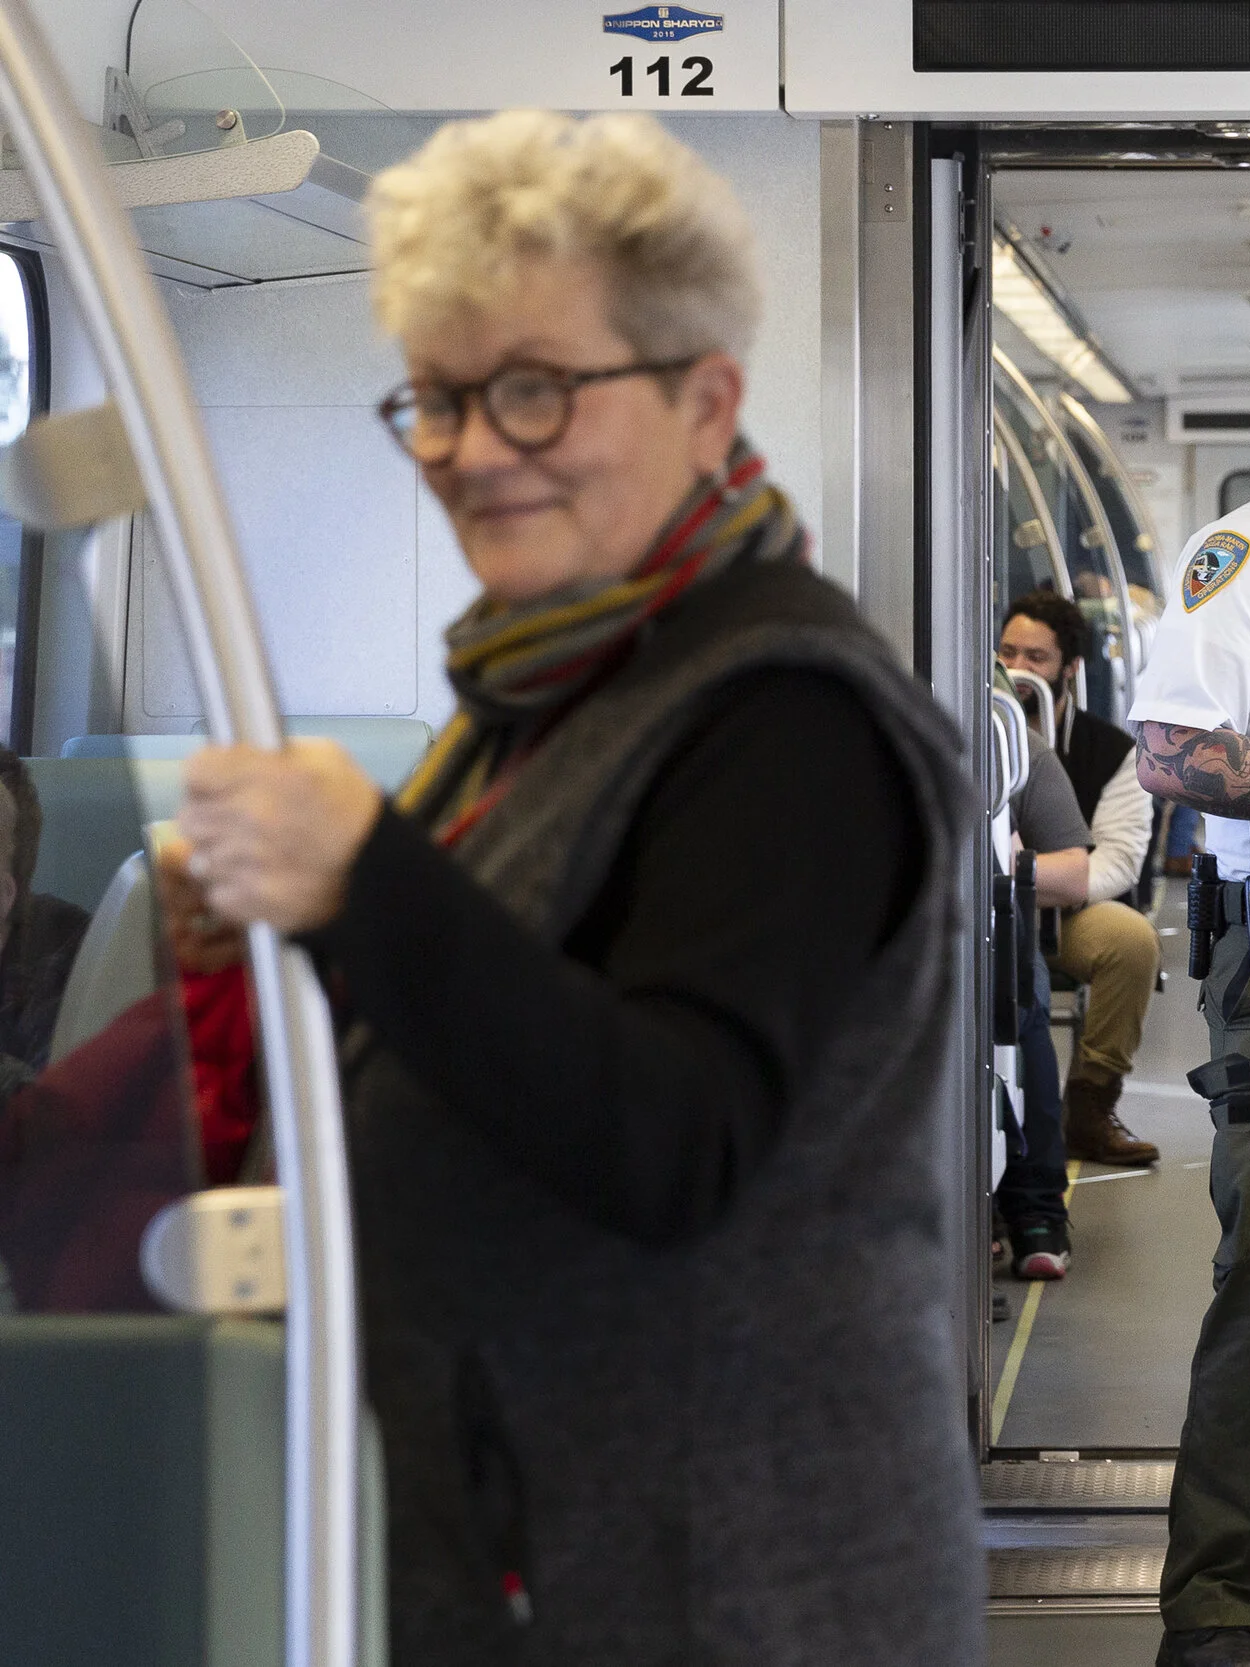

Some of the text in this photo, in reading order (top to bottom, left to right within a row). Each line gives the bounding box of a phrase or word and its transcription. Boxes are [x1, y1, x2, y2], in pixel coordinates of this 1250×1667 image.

[611, 20, 715, 28] NIPPON SHARYO
[609, 56, 714, 96] 112
[1196, 562, 1238, 599] OPERATIONS
